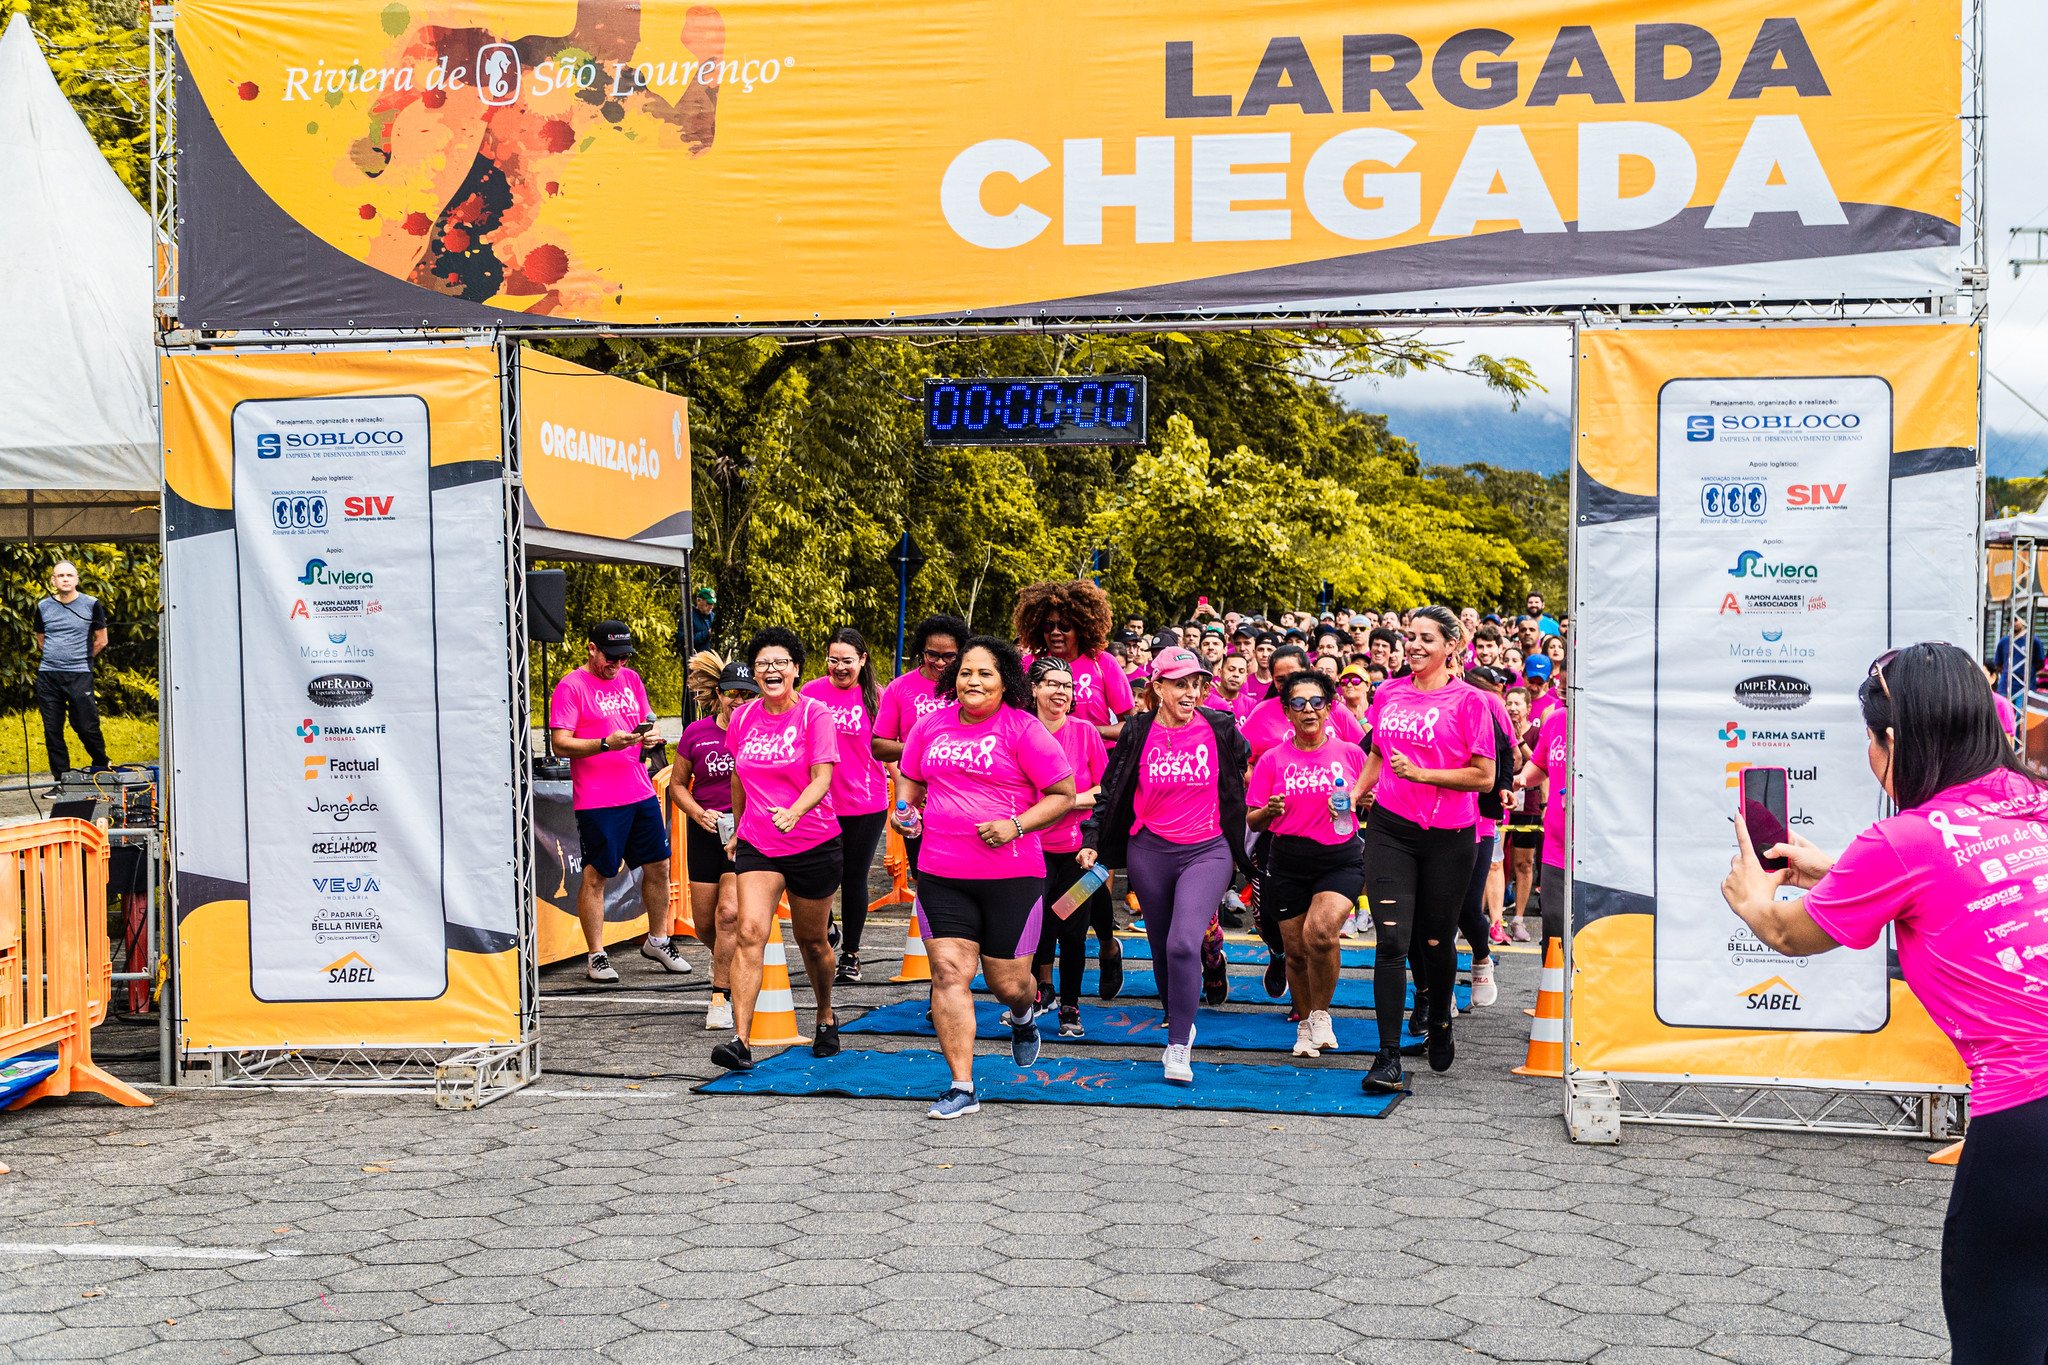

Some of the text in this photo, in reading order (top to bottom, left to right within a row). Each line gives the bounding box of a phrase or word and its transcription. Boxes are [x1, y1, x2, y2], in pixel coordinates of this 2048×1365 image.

[1164, 16, 1831, 119] LARGADA
[282, 59, 414, 101] Riviera
[425, 56, 466, 92] de
[531, 58, 596, 96] São
[940, 114, 1849, 249] CHEGADA
[931, 383, 1135, 430] 00:00:00
[1804, 398, 1839, 406] realização:
[1721, 414, 1860, 429] SOBLOCO
[286, 431, 403, 447] SOBLOCO
[323, 450, 379, 458] DESENVOLVIMENTO
[540, 421, 660, 481] ORGANIZAÇÃO
[329, 474, 354, 482] logístico:
[1787, 483, 1847, 505] SIV
[344, 496, 394, 517] SIV
[298, 558, 373, 585] Riviera
[1728, 550, 1818, 578] Riviera
[366, 604, 382, 615] 1988
[1808, 601, 1826, 612] 1988
[300, 645, 374, 658] Marés Altas
[1730, 644, 1815, 657] Marés Altas
[310, 678, 372, 690] IMPERADOR
[1739, 679, 1810, 692] IMPERADOR
[600, 698, 630, 711] ROSA
[832, 714, 847, 725] SA
[1380, 717, 1417, 734] ROSA
[324, 727, 353, 735] FARMA
[1379, 731, 1417, 741] RIVIERA
[1752, 731, 1788, 740] FARMA
[742, 741, 779, 755] ROSA
[928, 746, 974, 762] ROSA
[1147, 746, 1197, 765] Outubro
[330, 758, 379, 772] Factual
[708, 761, 735, 772] ROS
[926, 760, 974, 769] RIVIERA
[1149, 761, 1194, 777] ROSA
[1284, 763, 1331, 781] Outubro
[1149, 775, 1194, 784] RIVIERA
[1787, 766, 1817, 781] tual
[1286, 774, 1331, 790] ROSA
[1286, 786, 1334, 796] RIVIERA
[307, 796, 379, 822] Jangada
[1954, 807, 1979, 818] EU
[1981, 797, 2027, 813] APOIO
[1952, 827, 2031, 867] Riviera de
[2004, 845, 2048, 864] SOB
[312, 877, 380, 893] VEJA
[312, 921, 383, 931] BELLA RIVIERA
[1728, 943, 1764, 952] BELLA
[328, 967, 375, 983] SABEL
[1747, 993, 1801, 1011] SABEL
